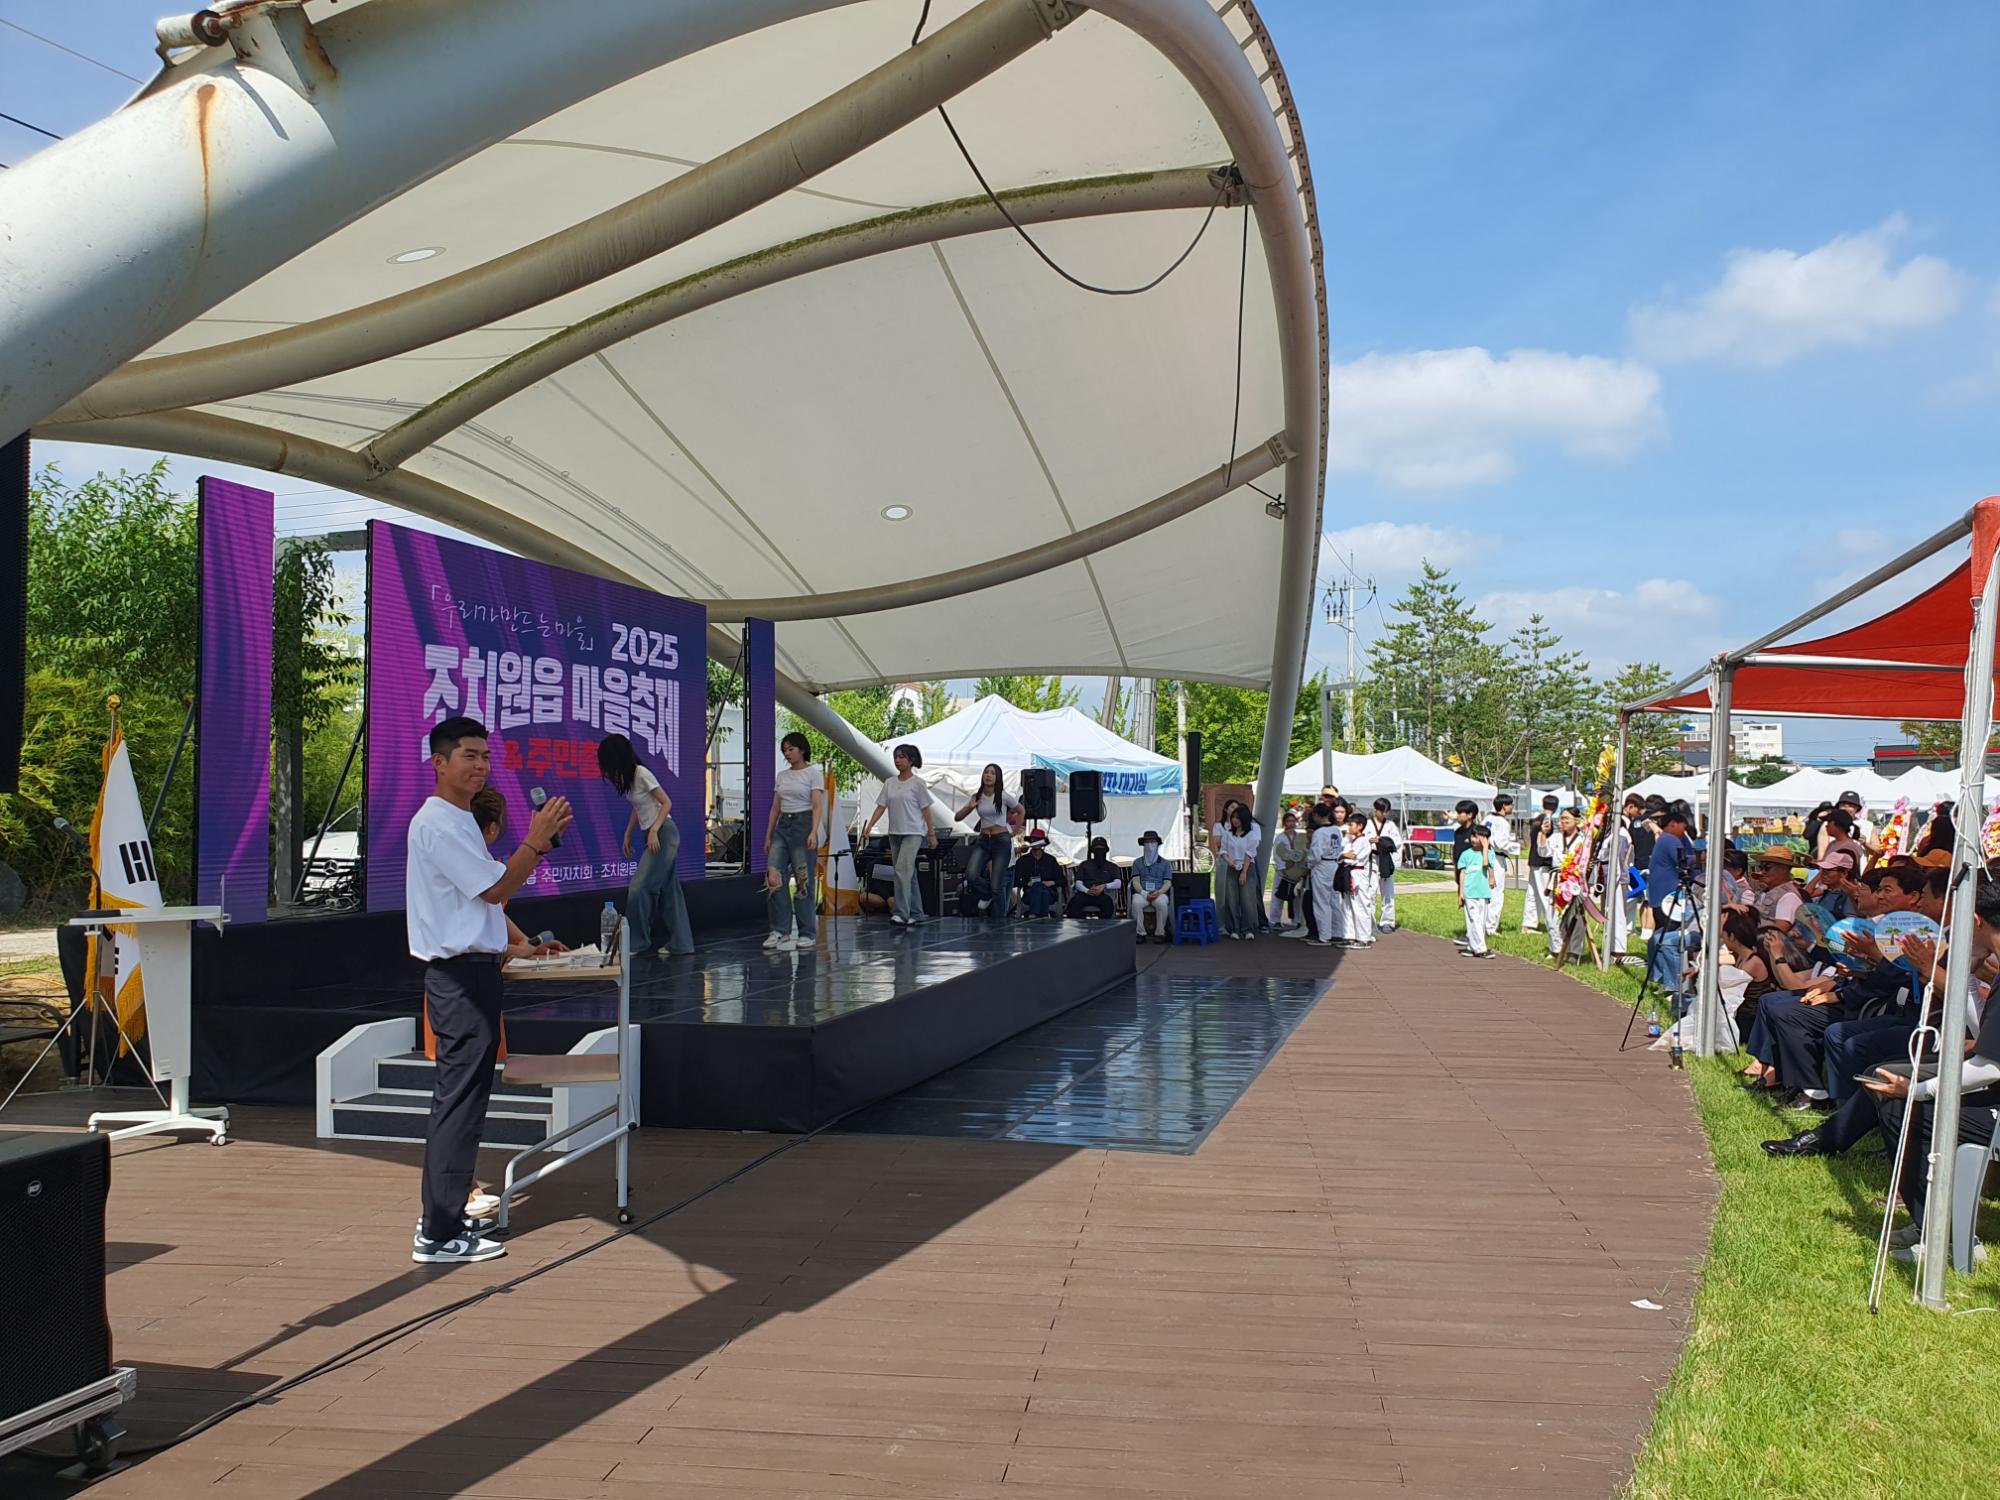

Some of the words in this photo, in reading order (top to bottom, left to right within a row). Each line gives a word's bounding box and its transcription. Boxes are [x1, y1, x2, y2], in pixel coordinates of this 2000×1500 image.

[611, 622, 679, 670] 2025
[421, 643, 564, 763] 조치원읍
[572, 663, 680, 778] 마을축제
[527, 737, 601, 779] 주민총
[541, 864, 593, 883] 주민자치회
[601, 861, 638, 878] 조치원읍
